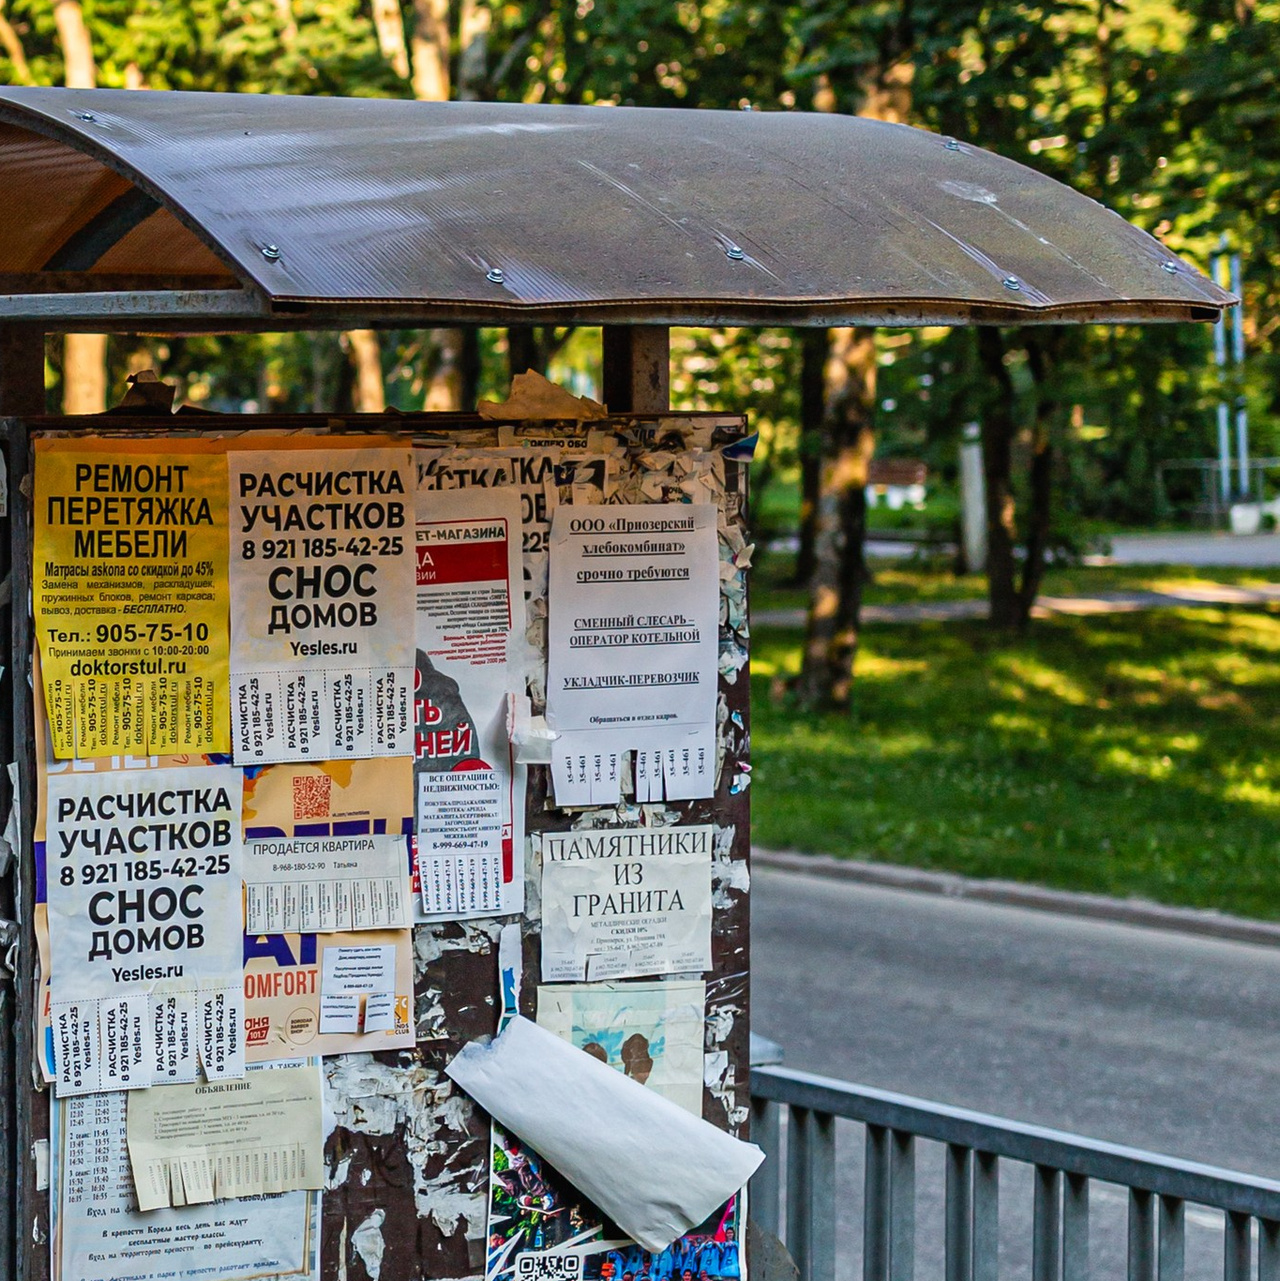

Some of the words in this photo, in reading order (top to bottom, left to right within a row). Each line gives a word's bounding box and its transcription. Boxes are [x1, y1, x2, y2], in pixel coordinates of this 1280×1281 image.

[75, 464, 190, 493] РЕМОНТ
[239, 470, 406, 498] РАСЧИСТКА
[47, 497, 215, 526] ПЕРЕТЯЖКА
[240, 502, 406, 533] УЧАСТКОВ
[570, 519, 605, 532] ООО
[609, 517, 694, 533] «Приозерский
[74, 530, 188, 558] МЕБЕЛИ
[241, 540, 256, 560] 8
[261, 539, 296, 559] 921
[302, 536, 405, 558] 185-42-25
[416, 526, 505, 542] ЕТ-МАГАЗИНА
[582, 540, 685, 554] хлебокомбинат»
[45, 562, 89, 579] Матрасы
[92, 564, 125, 576] askona
[128, 566, 139, 576] со
[141, 562, 180, 578] скидкой
[181, 566, 193, 577] до
[195, 561, 215, 576] 45%
[268, 563, 379, 601] СНОС
[577, 569, 623, 582] срочно
[626, 566, 689, 581] требуются
[41, 593, 95, 604] пружинных
[99, 591, 134, 603] блоков,
[138, 592, 172, 604] ремонт
[176, 591, 215, 602] каркаса;
[42, 580, 78, 589] Замена
[86, 579, 146, 590] механизмов,
[153, 578, 215, 591] раскладушек,
[41, 606, 72, 616] вывоз,
[74, 606, 116, 616] доставка
[123, 603, 187, 615] БЕСПЛАТНО.
[268, 602, 379, 635] ДОМОВ
[574, 615, 634, 629] СМЕННЫЙ
[637, 614, 686, 627] СЛЕСАРЬ
[48, 629, 91, 642] Тел.:
[96, 622, 210, 643] 905-75-10
[569, 632, 629, 646] ОПЕРАТОР
[631, 628, 700, 643] КОТЕЛЬНОЙ
[48, 646, 101, 658] Принимаем
[107, 647, 142, 656] звонки
[143, 648, 150, 656] с
[151, 644, 210, 656] 10:00-20:00
[289, 640, 359, 656] Yesles.ru
[70, 658, 187, 677] doktorstul.ru
[563, 671, 700, 687] УКЛАДЧИК-ПЕРЕВОЗЧИК
[123, 677, 133, 731] 905-75-10
[194, 676, 204, 730] 905-75-10
[249, 677, 261, 729] 185-42-25
[297, 675, 308, 727] 185-42-25
[344, 673, 353, 725] 185-42-25
[376, 677, 385, 744] РАСЧИСТКА
[386, 671, 395, 723] 185-42-25
[398, 686, 407, 735] Yesles.ru
[134, 682, 144, 745] doktorstul.ru
[207, 681, 215, 743] doktorstul.ru
[238, 684, 250, 752] РАСЧИСТКА
[265, 693, 274, 741] Yesles.ru
[287, 681, 296, 749] РАСЧИСТКА
[310, 690, 321, 738] Yesles.ru
[333, 679, 343, 746] РАСЧИСТКА
[356, 688, 365, 736] Yesles.ru
[589, 715, 630, 724] Обращаться
[253, 730, 262, 748] 921
[300, 727, 308, 746] 921
[345, 726, 353, 744] 921
[387, 724, 395, 743] 921
[387, 742, 396, 750] 8
[255, 749, 264, 757] 8
[609, 753, 617, 781] 35-461
[682, 748, 690, 776] 35-461
[428, 774, 445, 782] ВСЕ
[446, 773, 488, 782] ОПЕРАЦИИ
[565, 756, 574, 784] 35-461
[579, 755, 588, 783] 35-461
[594, 754, 602, 782] 35-461
[423, 783, 500, 794] НЕДВИЖИМОСТЬЮ:
[57, 788, 232, 823] РАСЧИСТКА
[58, 819, 232, 858] УЧАСТКОВ
[253, 838, 320, 856] ПРОДАЁТСЯ
[322, 839, 375, 853] КВАРТИРА
[432, 841, 488, 850] 8-999-669-47-19
[548, 831, 707, 862] ПАМЯТНИКИ
[59, 866, 75, 886] 8
[82, 863, 117, 885] 921
[124, 854, 231, 881] 185-42-25
[272, 862, 326, 872] 8-968-180-52-90
[333, 861, 358, 870] Татьяна
[613, 863, 644, 886] ИЗ
[88, 884, 205, 925] СНОС
[572, 889, 685, 917] ГРАНИТА
[88, 924, 205, 962] ДОМОВ
[111, 965, 184, 982] Yesles.ru
[244, 970, 318, 1000] OMFORT
[194, 1082, 251, 1096] ОБЪЯВЛЕНИЕ
